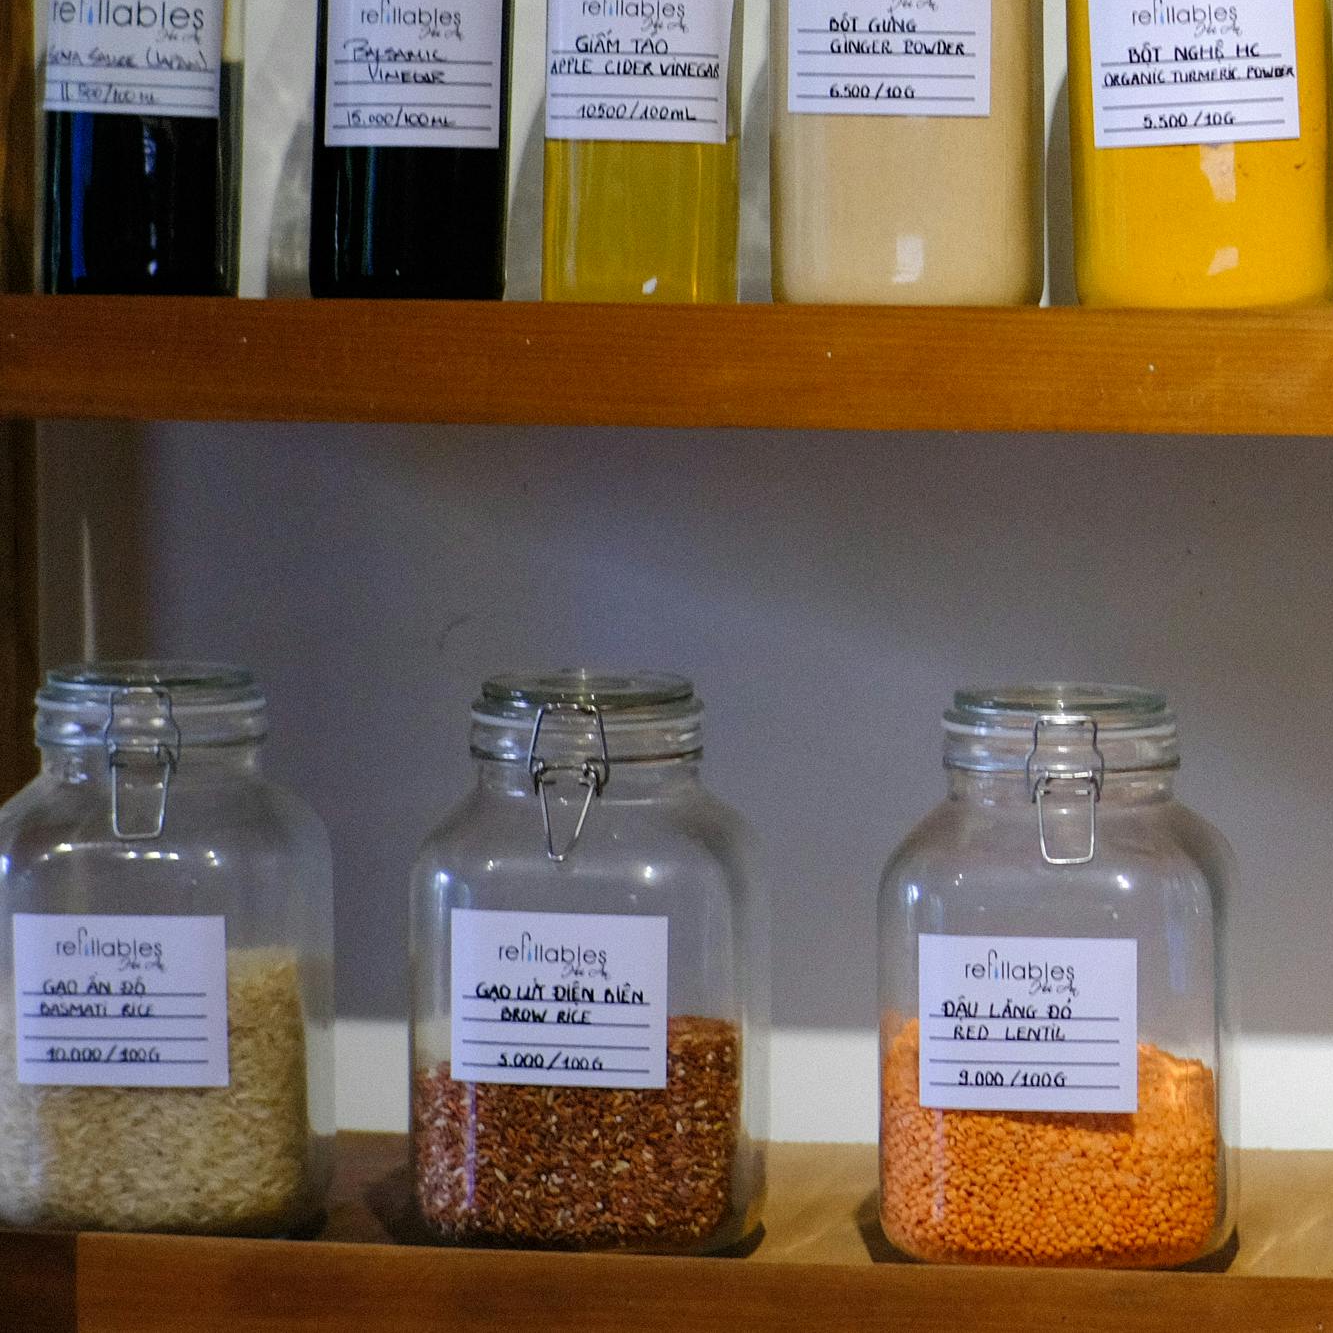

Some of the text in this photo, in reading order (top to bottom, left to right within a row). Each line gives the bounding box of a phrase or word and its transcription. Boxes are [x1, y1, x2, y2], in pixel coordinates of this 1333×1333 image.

[905, 42, 964, 55] POWDER
[1236, 43, 1260, 57] HC
[551, 59, 591, 75] APPLE
[1247, 66, 1294, 79] POWDER
[57, 927, 162, 956] refillables
[500, 932, 606, 965] refillables
[966, 950, 1074, 982] refillables
[501, 1008, 546, 1022] BROW
[954, 1026, 988, 1040] RED
